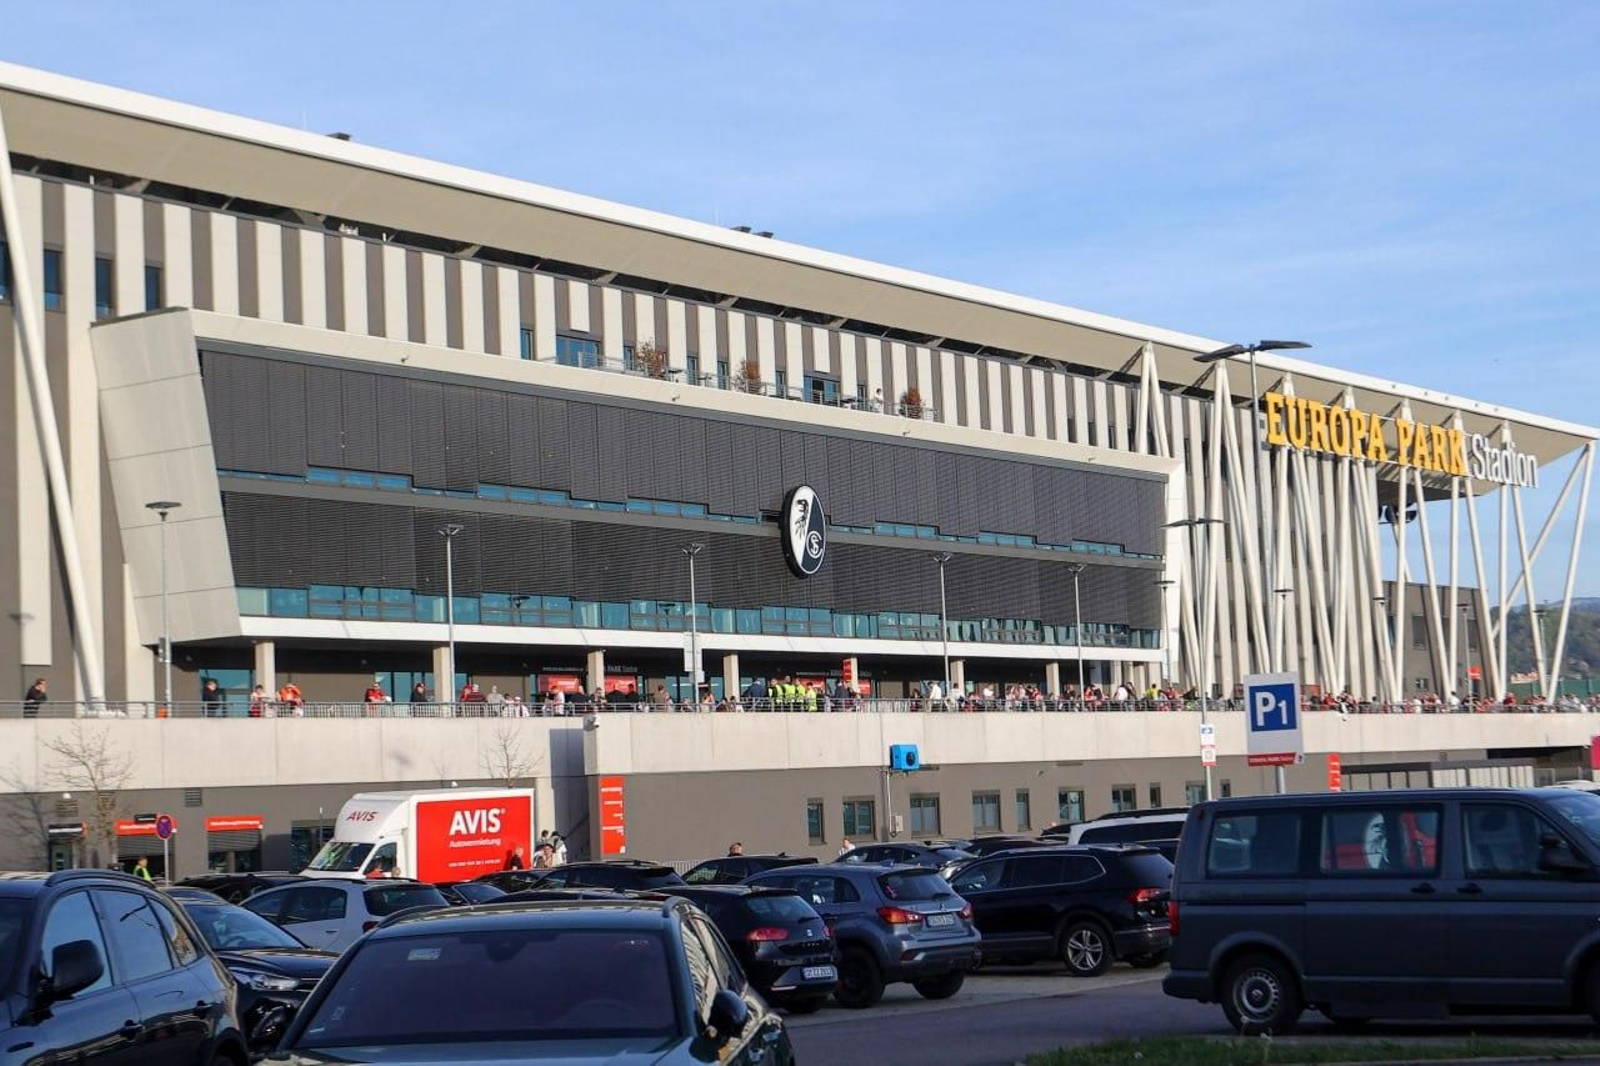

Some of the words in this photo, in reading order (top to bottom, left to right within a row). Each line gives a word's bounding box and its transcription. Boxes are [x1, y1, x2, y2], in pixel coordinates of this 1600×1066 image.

[1265, 391, 1388, 461] EUROPA
[1396, 417, 1467, 476] PARK
[1472, 433, 1538, 488] Stadion
[345, 811, 378, 822] AVIS
[449, 808, 501, 835] AVIS
